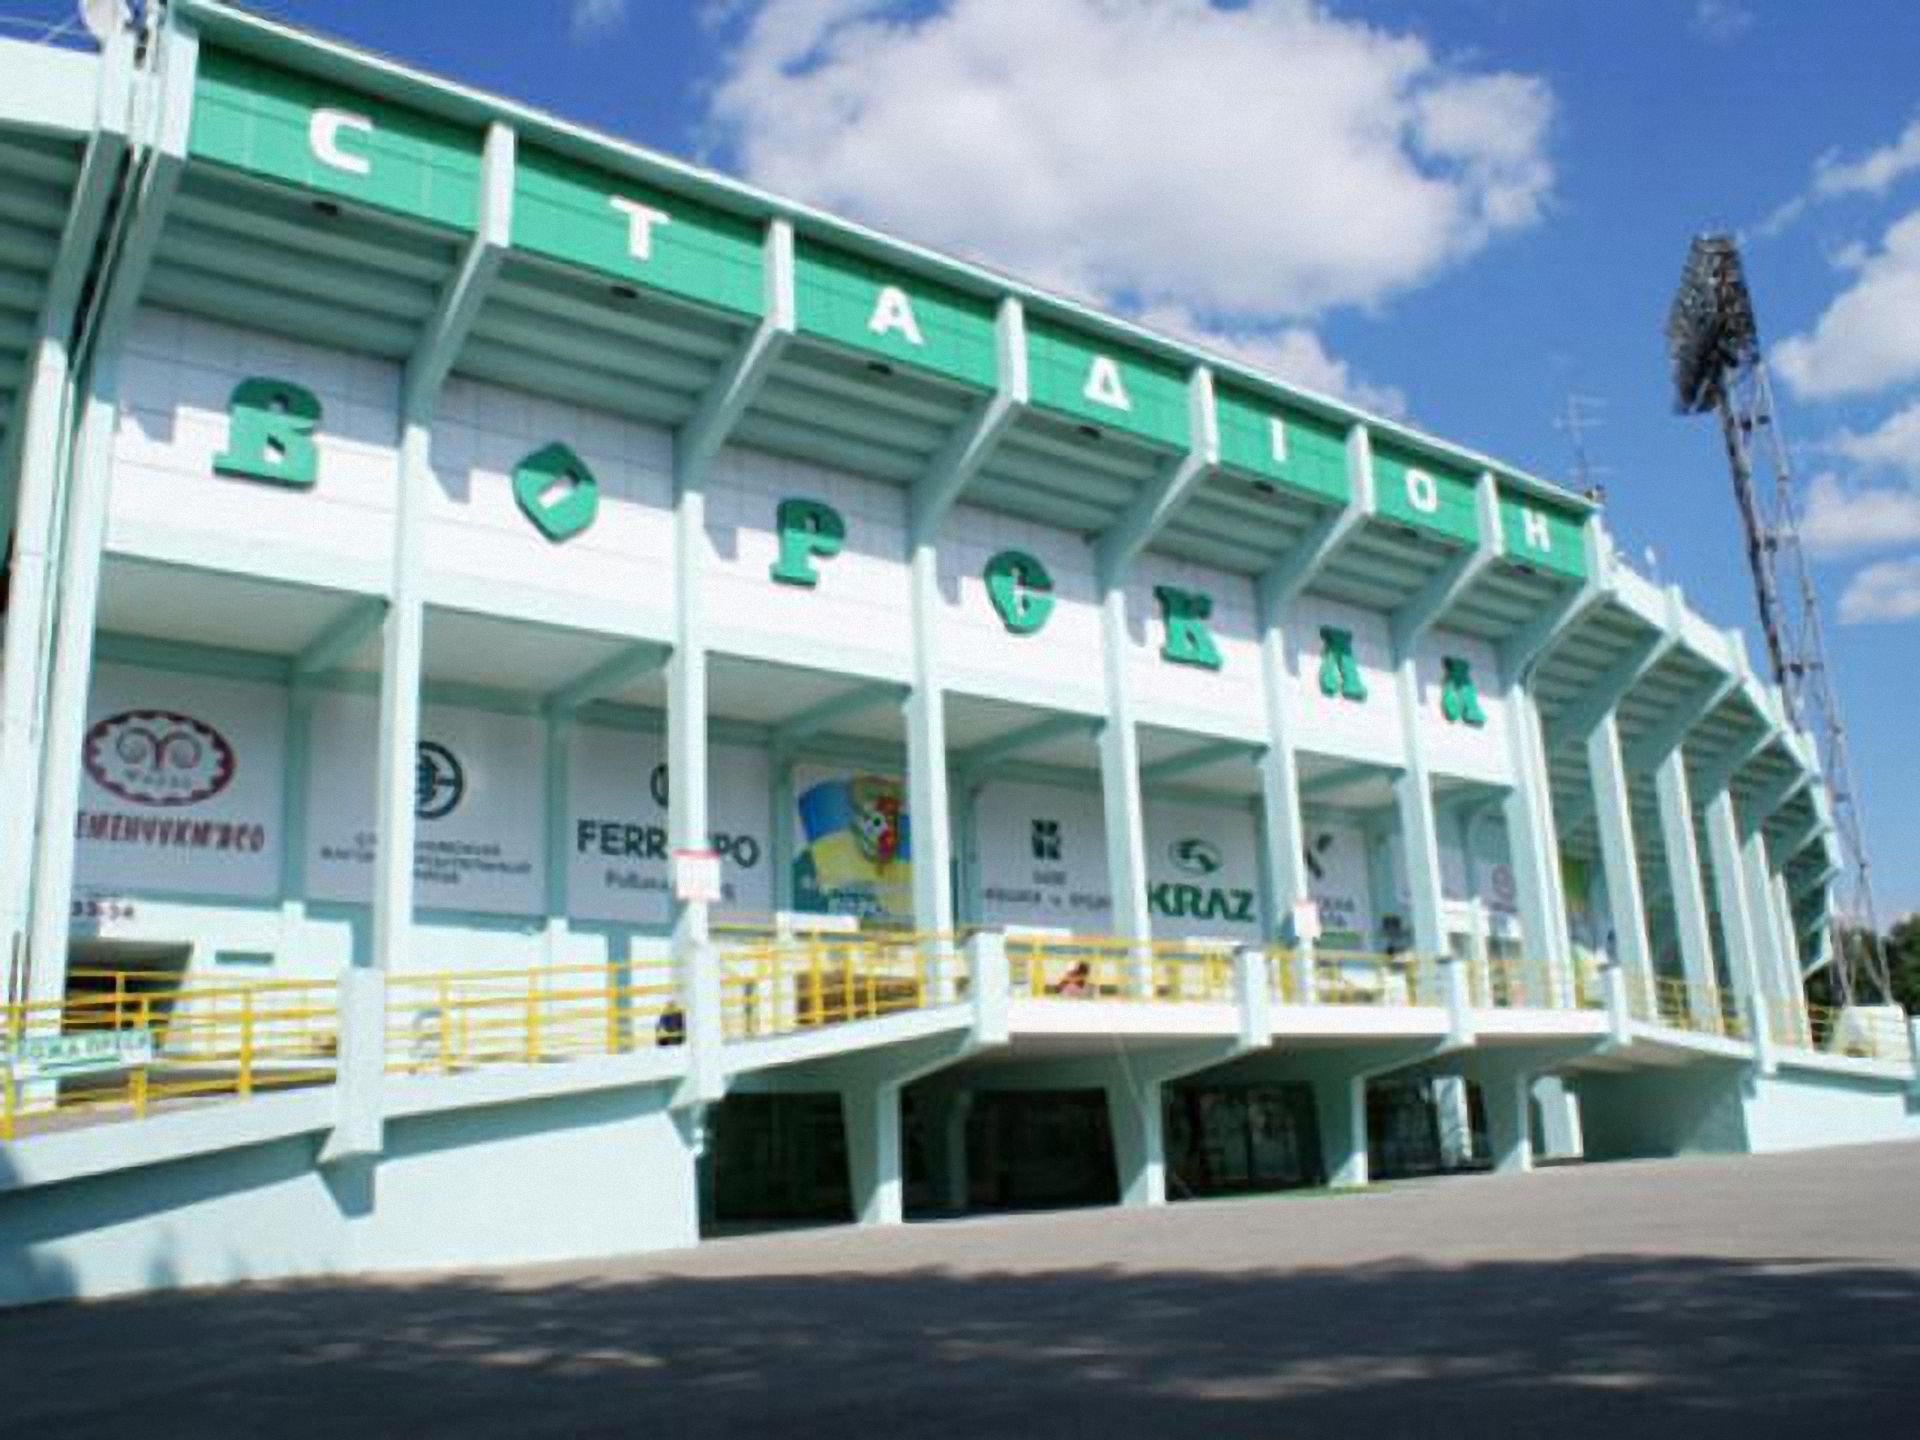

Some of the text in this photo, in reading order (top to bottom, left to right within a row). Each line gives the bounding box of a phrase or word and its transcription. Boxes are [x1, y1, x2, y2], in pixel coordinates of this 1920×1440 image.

[309, 107, 1551, 553] СТАДІОН
[212, 376, 1486, 726] ВОРСКЛА
[577, 819, 761, 868] FERRPO
[1147, 883, 1256, 922] KRAZ
